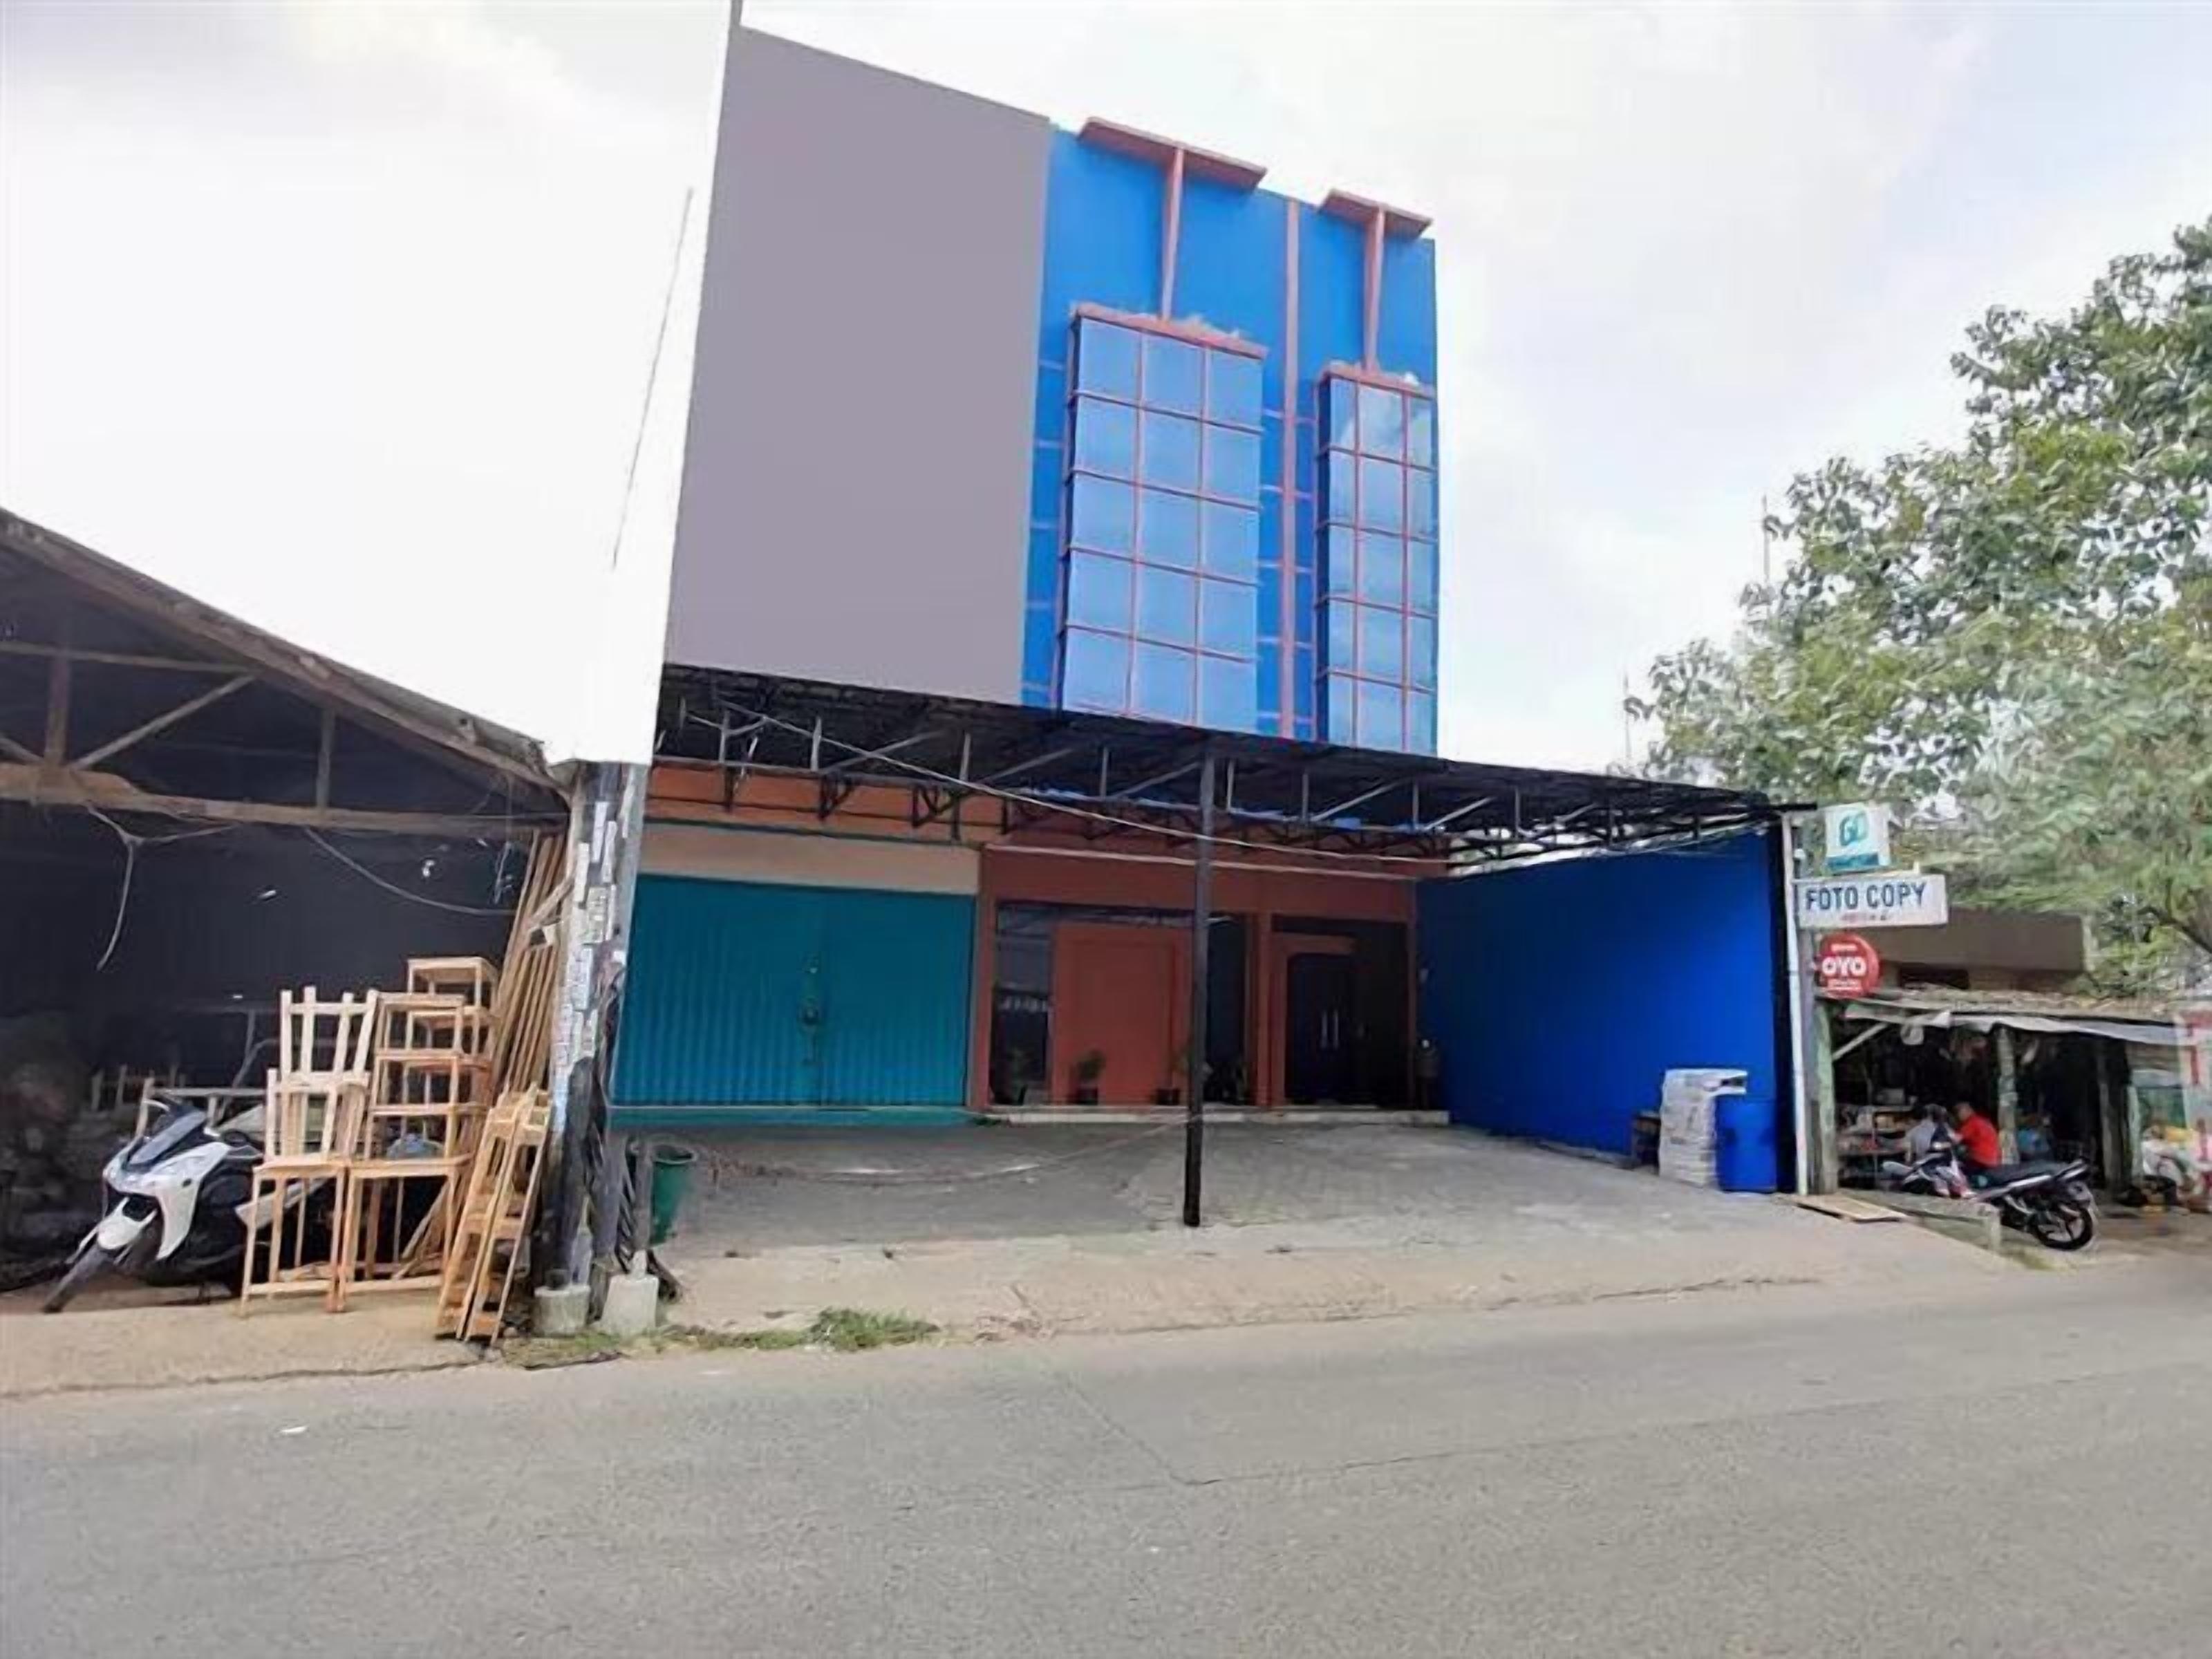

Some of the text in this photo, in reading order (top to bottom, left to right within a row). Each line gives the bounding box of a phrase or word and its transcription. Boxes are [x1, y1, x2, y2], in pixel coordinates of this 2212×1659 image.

[1806, 883, 1925, 910] FOTO COPY
[1821, 957, 1866, 976] OYO
